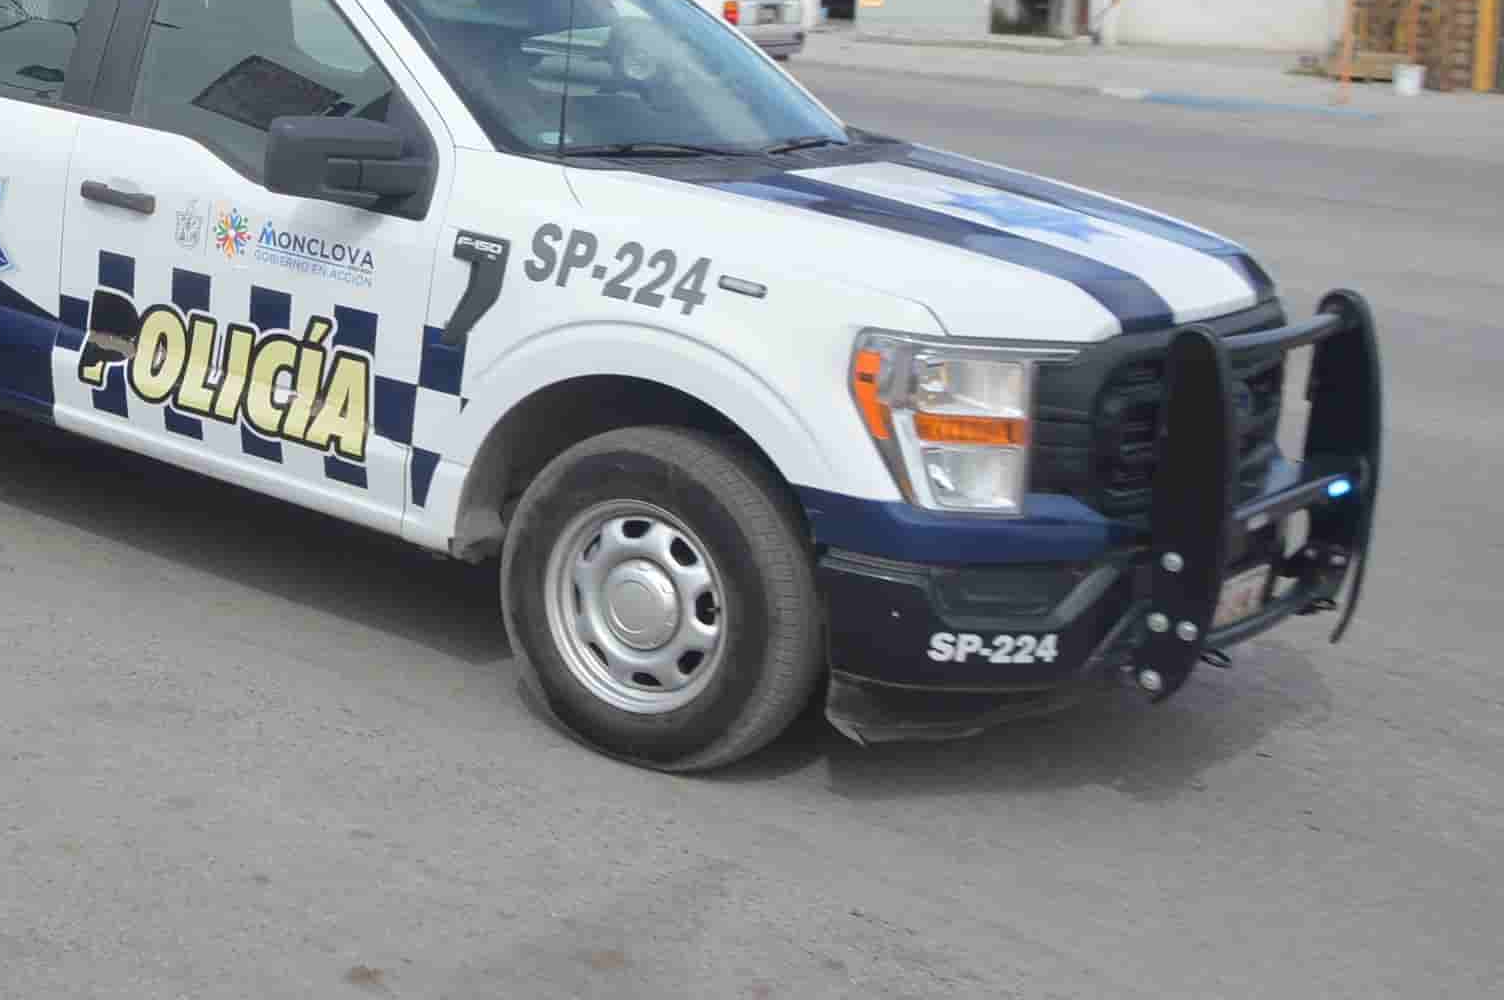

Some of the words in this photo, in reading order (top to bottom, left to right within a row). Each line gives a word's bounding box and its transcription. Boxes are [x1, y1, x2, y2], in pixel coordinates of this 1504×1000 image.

[257, 221, 375, 269] MONCLOVA
[524, 222, 712, 316] SP-224
[78, 286, 372, 463] POLICÍA
[927, 632, 1059, 664] SP-224
